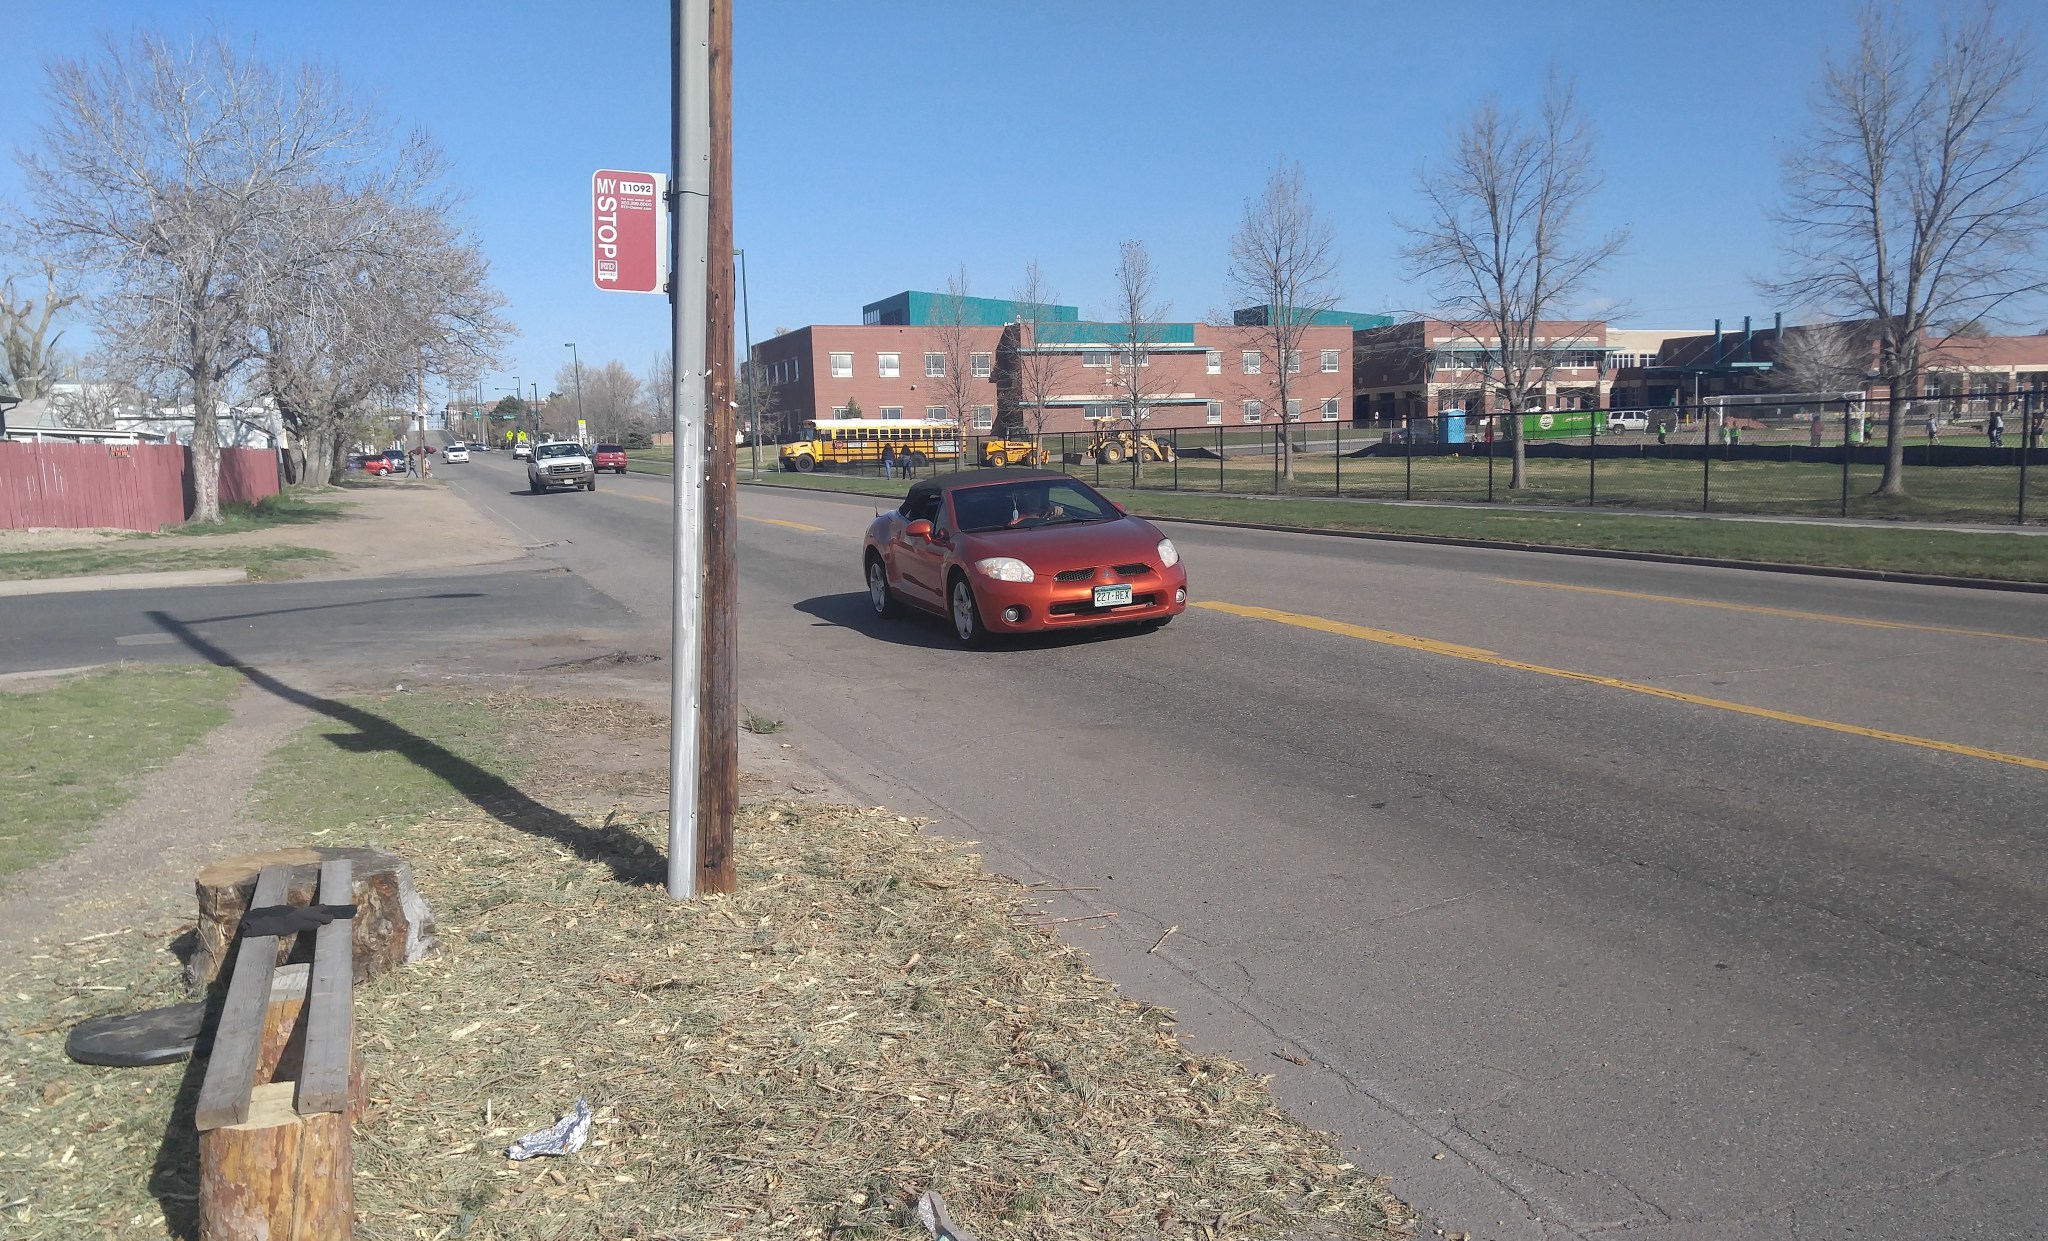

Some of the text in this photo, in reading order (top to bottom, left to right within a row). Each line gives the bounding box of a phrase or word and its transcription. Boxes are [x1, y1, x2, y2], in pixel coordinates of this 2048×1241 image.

[597, 178, 617, 195] MY
[622, 184, 651, 193] 11092
[598, 196, 618, 258] STOP
